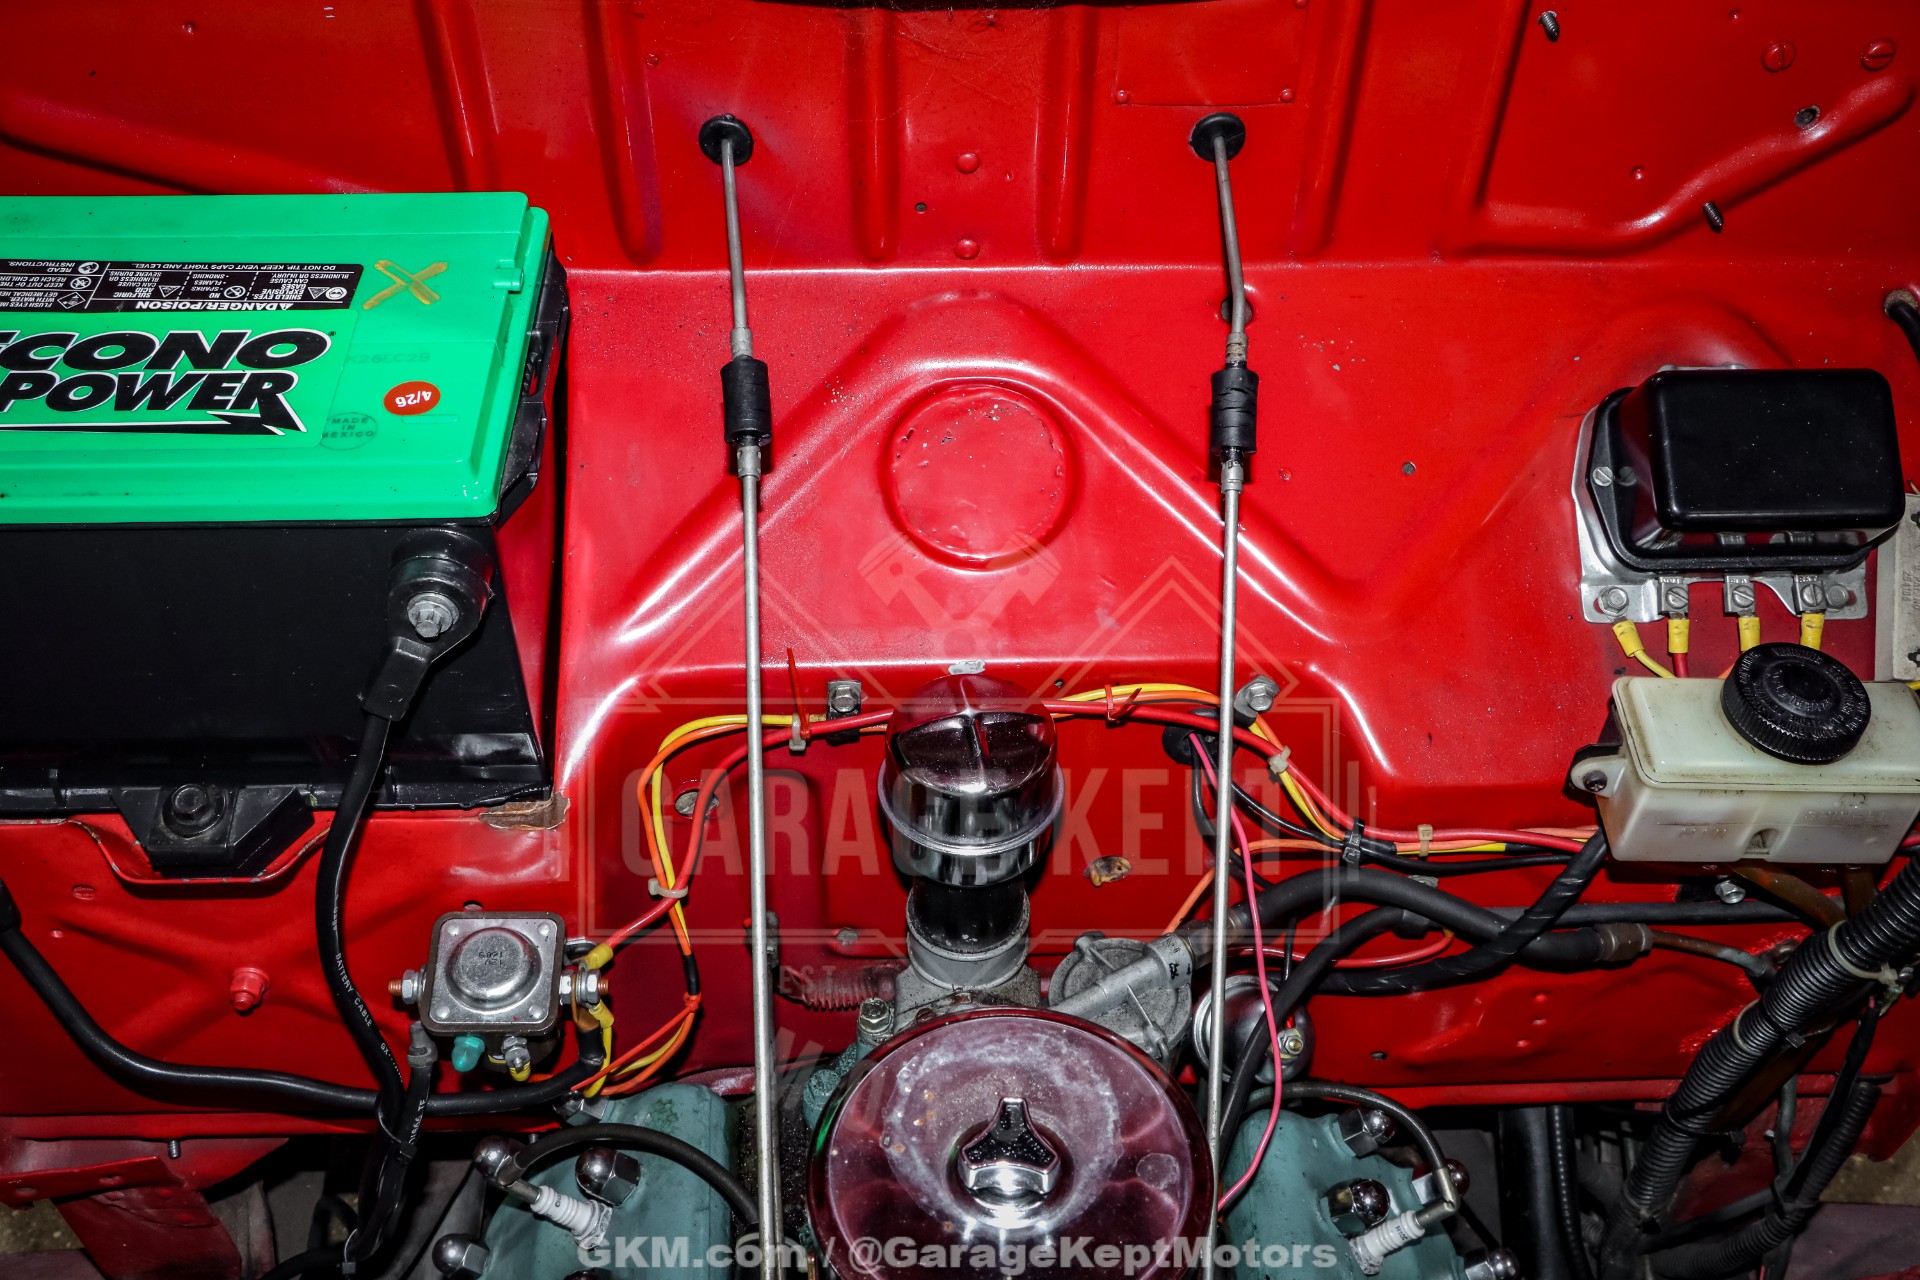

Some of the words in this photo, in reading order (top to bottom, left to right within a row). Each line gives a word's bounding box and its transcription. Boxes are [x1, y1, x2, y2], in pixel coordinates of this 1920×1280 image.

[136, 301, 278, 310] DANGER/POISON
[1, 370, 304, 426] POWER
[395, 390, 432, 408] 4/26
[335, 952, 354, 993] BATTERY
[354, 997, 373, 1027] CABLE
